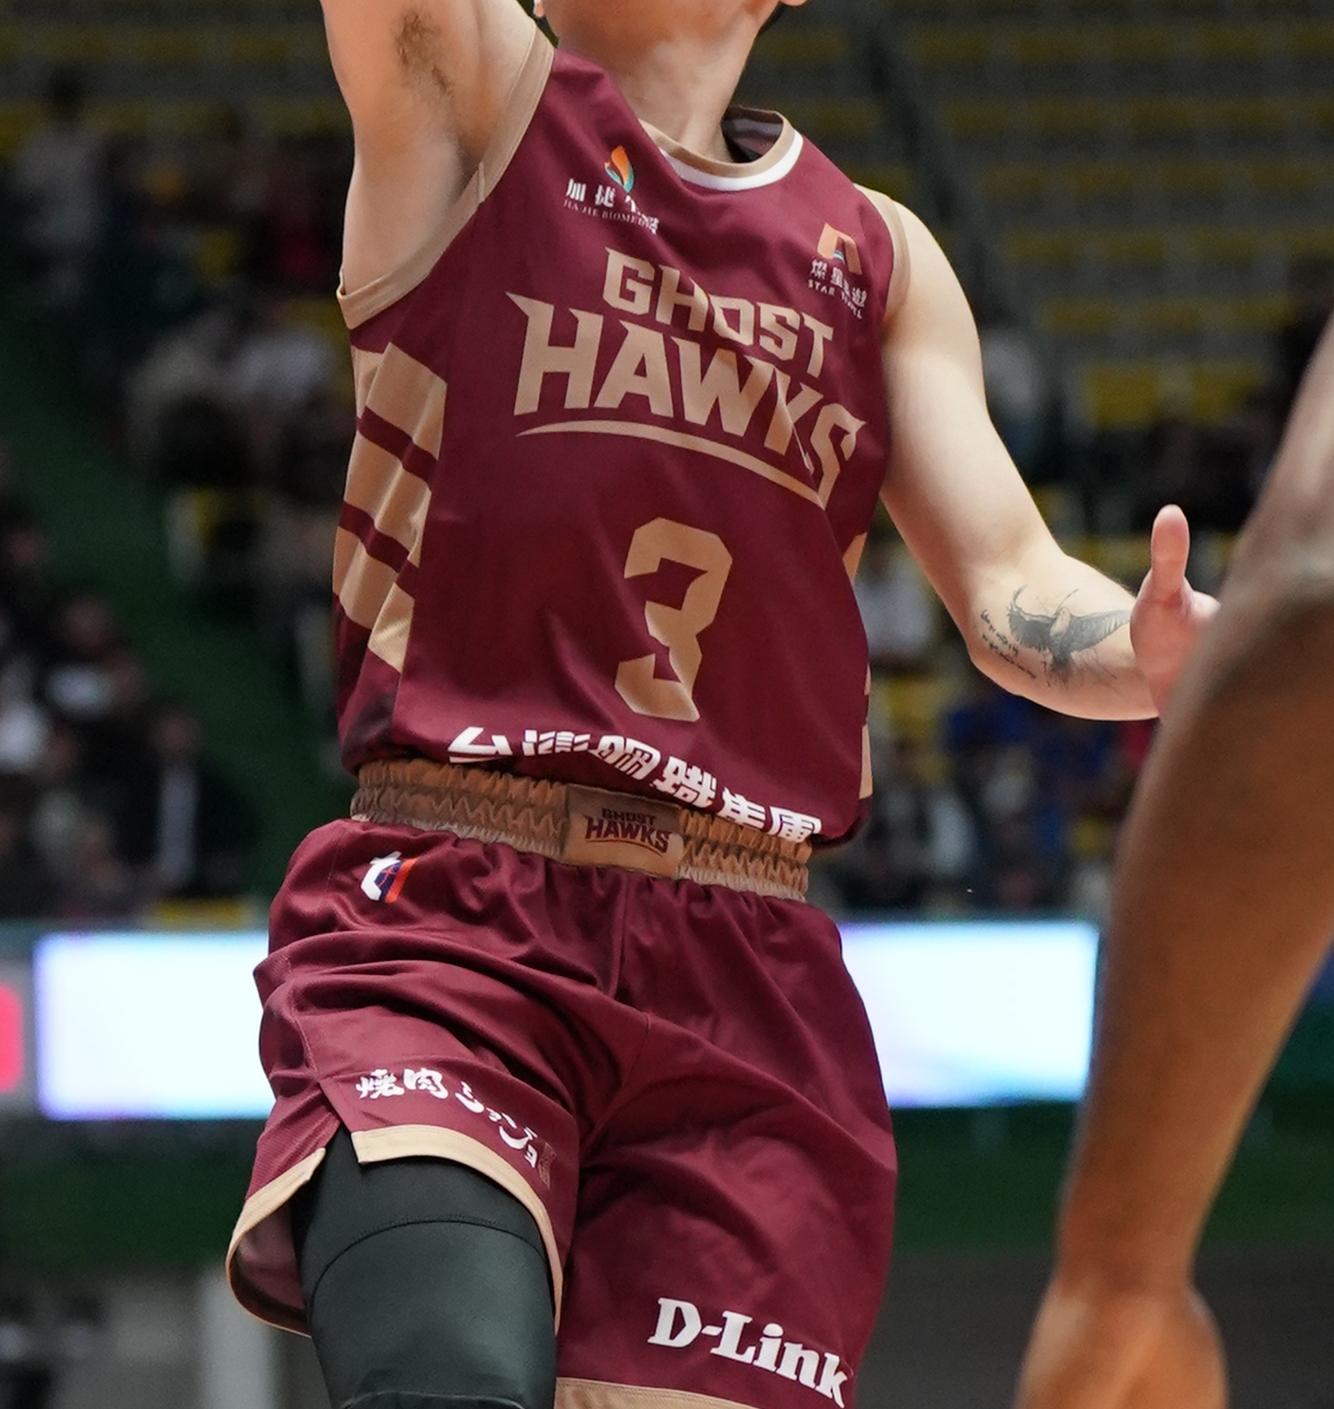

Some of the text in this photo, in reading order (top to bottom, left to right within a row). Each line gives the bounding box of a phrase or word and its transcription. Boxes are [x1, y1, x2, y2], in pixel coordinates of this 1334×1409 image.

[602, 246, 834, 379] GHOST
[505, 291, 867, 497] HAWKS
[614, 516, 734, 722] 3
[583, 814, 670, 854] HAWKS
[600, 807, 657, 827] GHOST
[648, 1297, 854, 1409] D-Link
